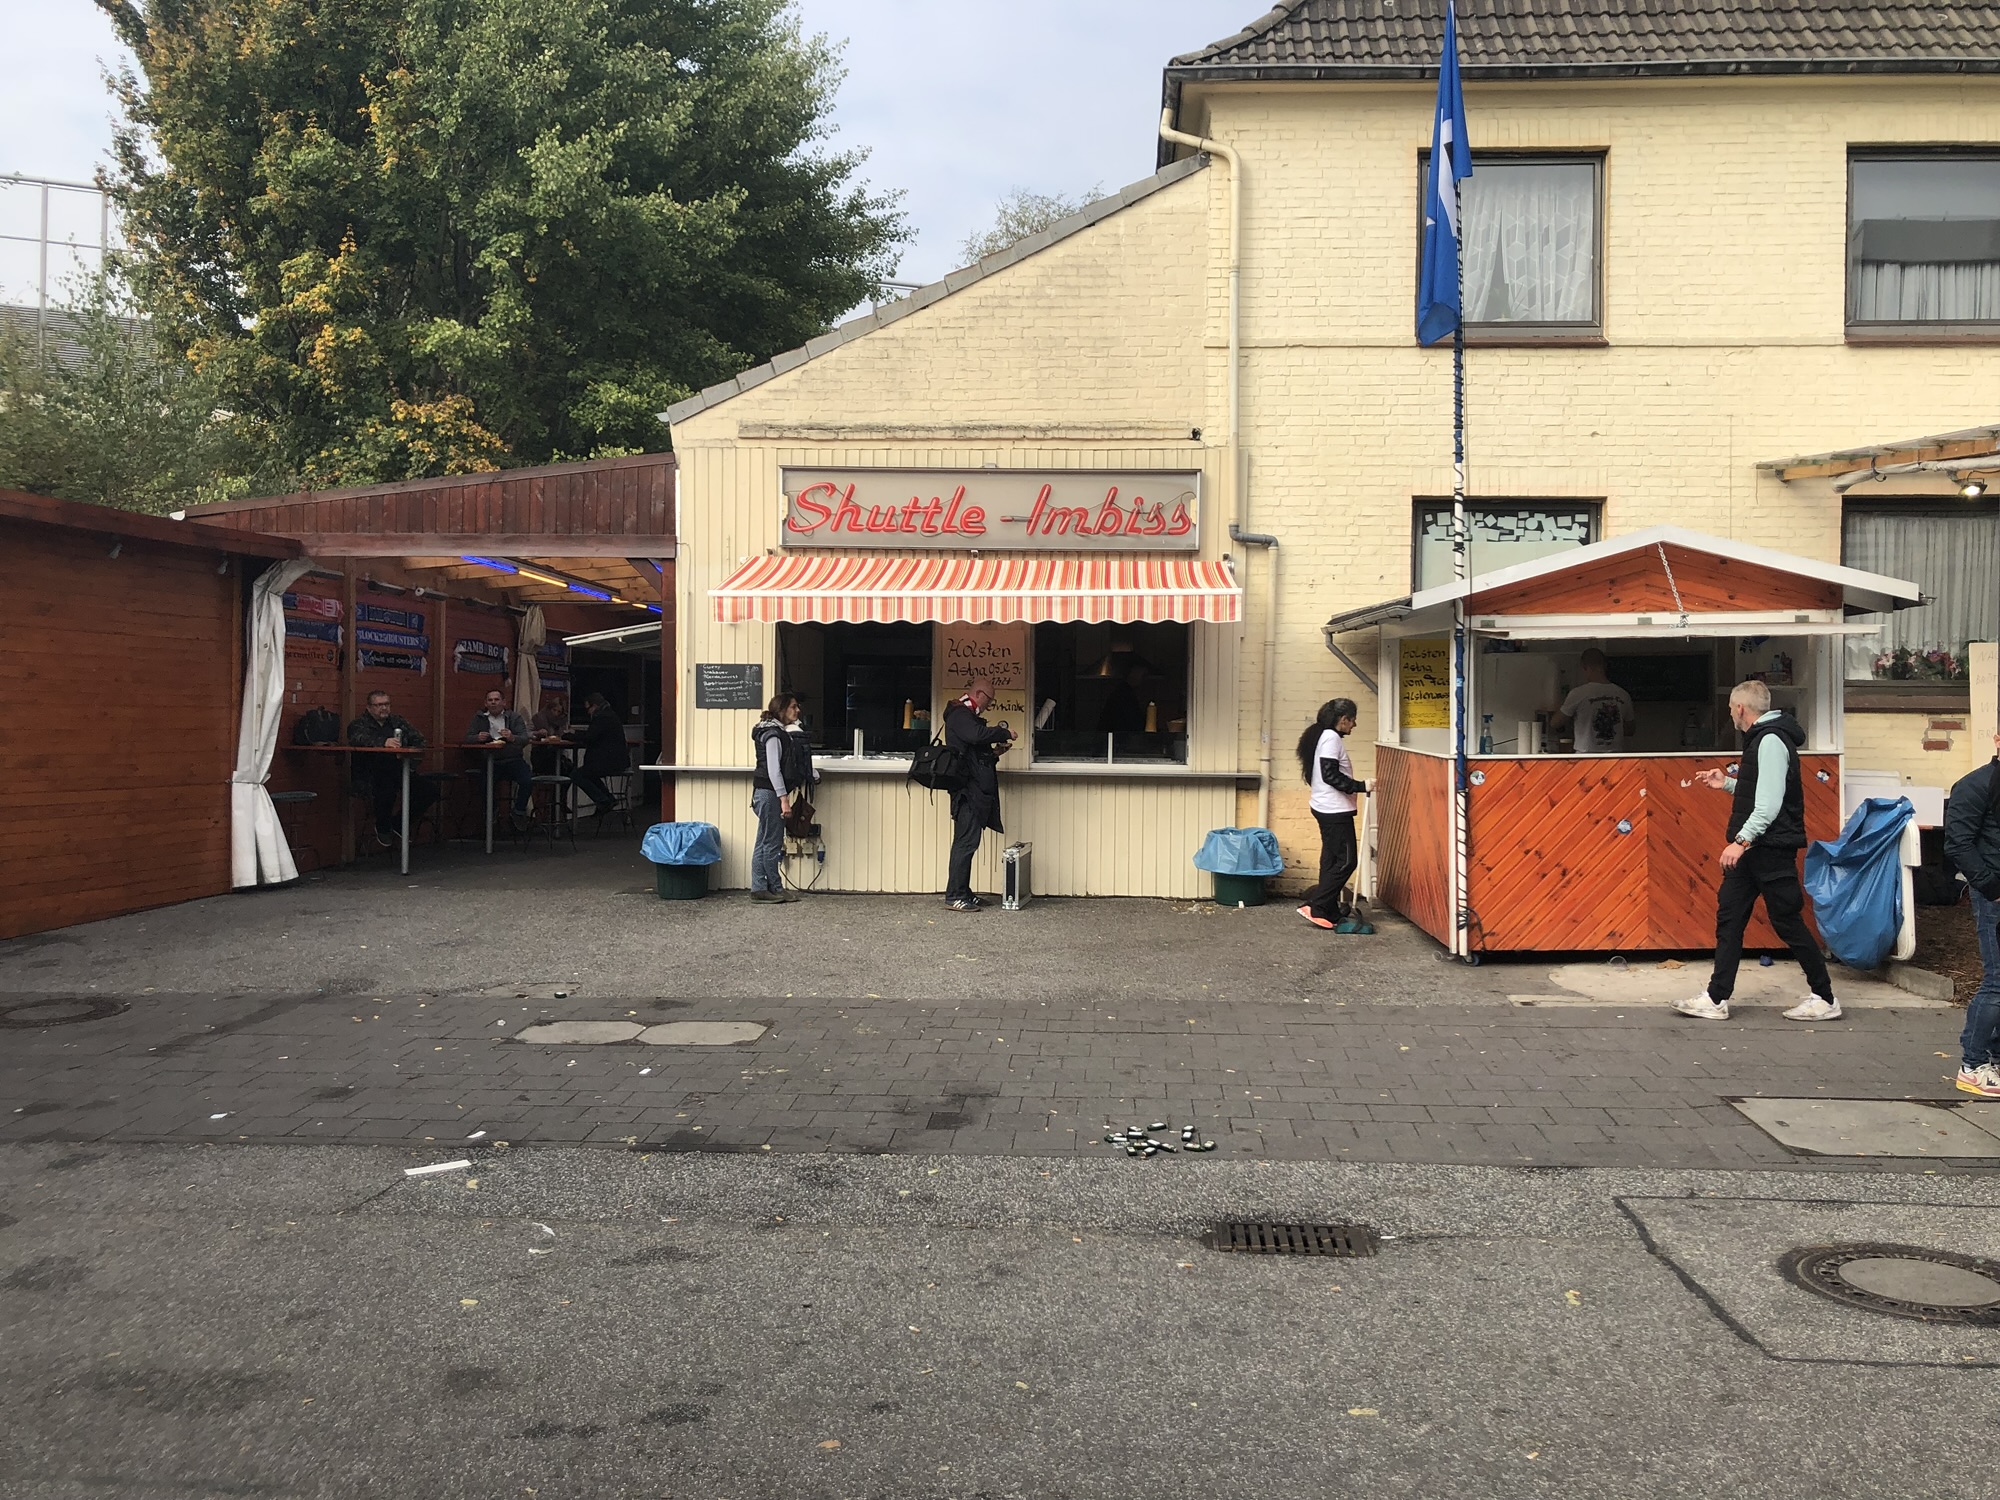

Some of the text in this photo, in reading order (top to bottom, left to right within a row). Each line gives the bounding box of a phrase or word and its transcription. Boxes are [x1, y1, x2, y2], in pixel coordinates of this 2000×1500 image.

[787, 482, 986, 535] Shuttle
[947, 638, 1012, 658] Holsten
[947, 662, 987, 677] Astra
